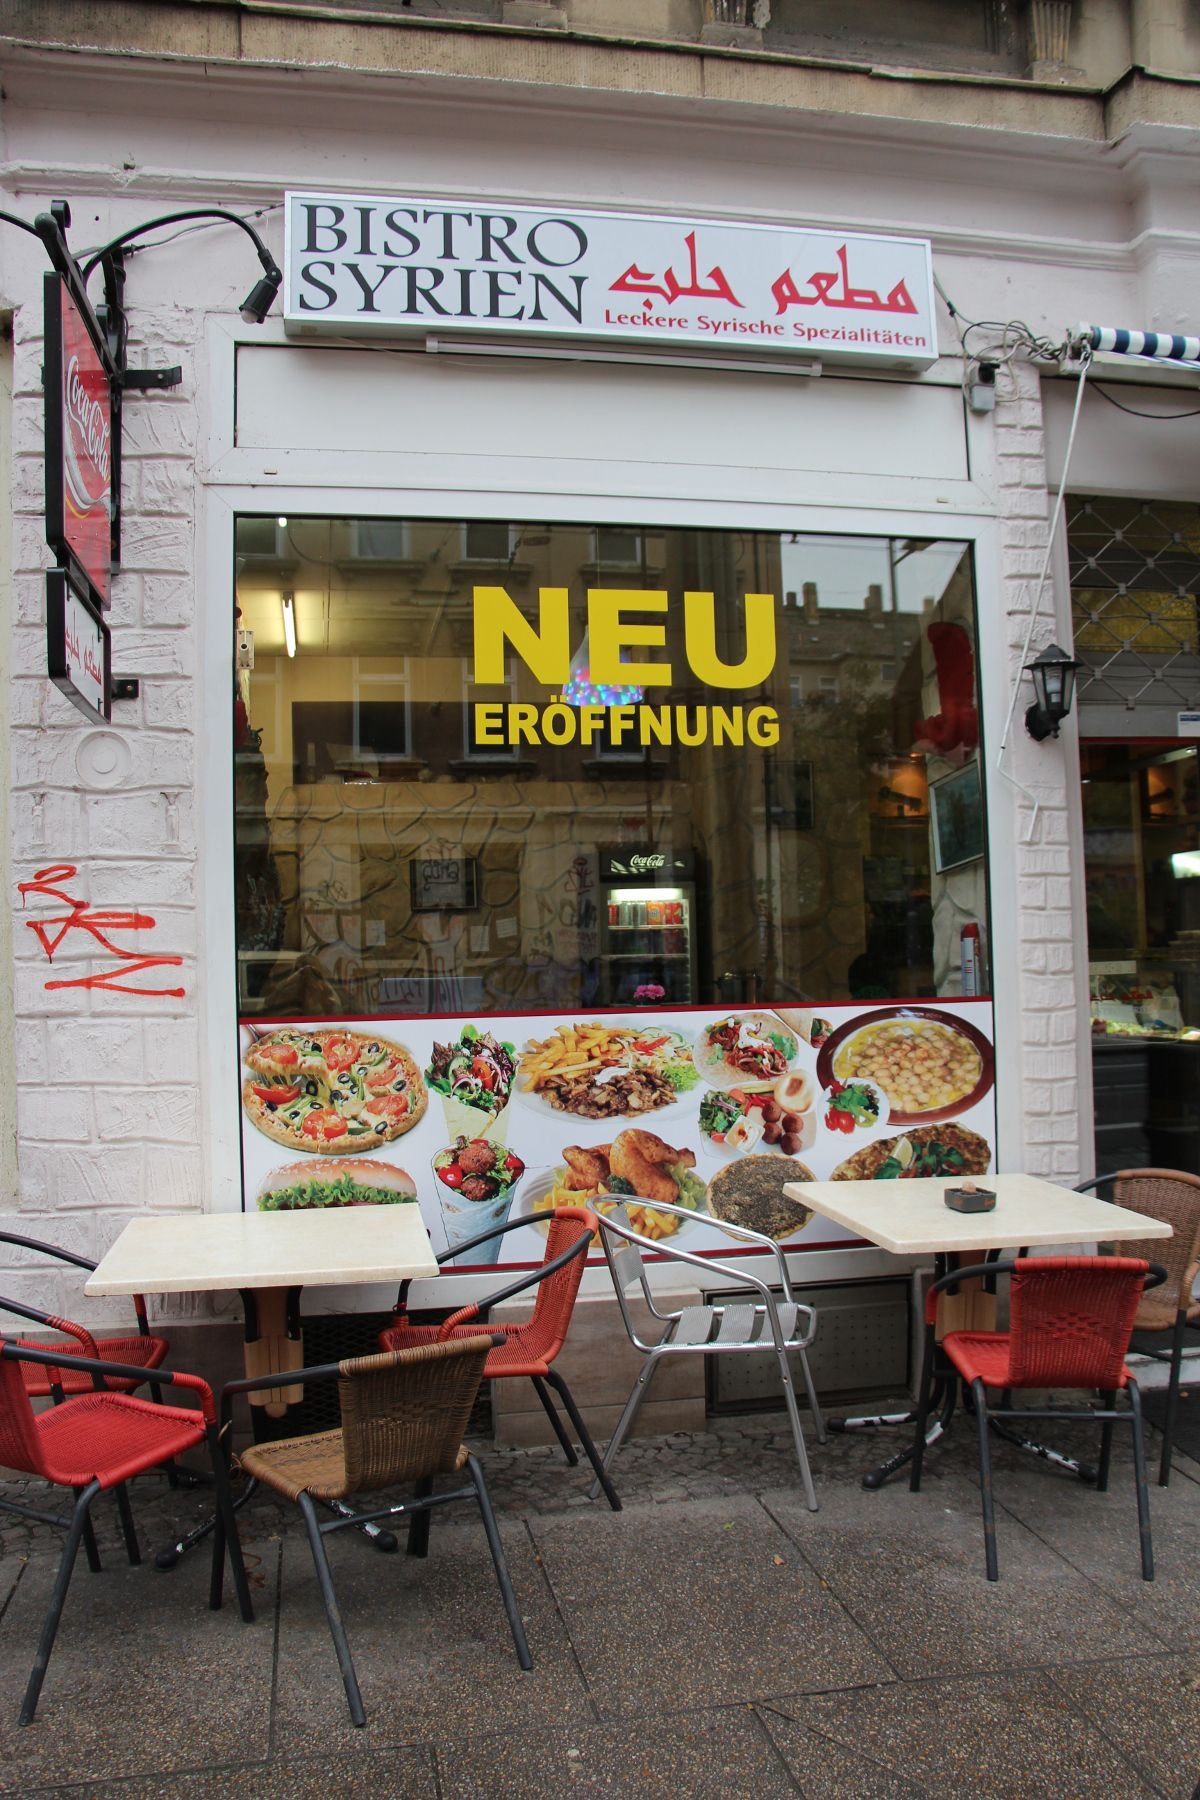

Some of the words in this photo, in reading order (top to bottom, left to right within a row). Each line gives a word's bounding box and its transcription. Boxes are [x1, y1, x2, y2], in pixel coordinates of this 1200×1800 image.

[300, 204, 588, 267] BISTRO
[299, 261, 589, 324] SYRIEN
[608, 230, 746, 311] حلب
[771, 243, 918, 315] مطعم
[604, 308, 689, 328] Leckere
[697, 315, 785, 336] Syrische
[793, 322, 927, 347] Spezialitäten
[473, 586, 777, 689] NEU
[474, 694, 780, 747] ERÖFFNUNG
